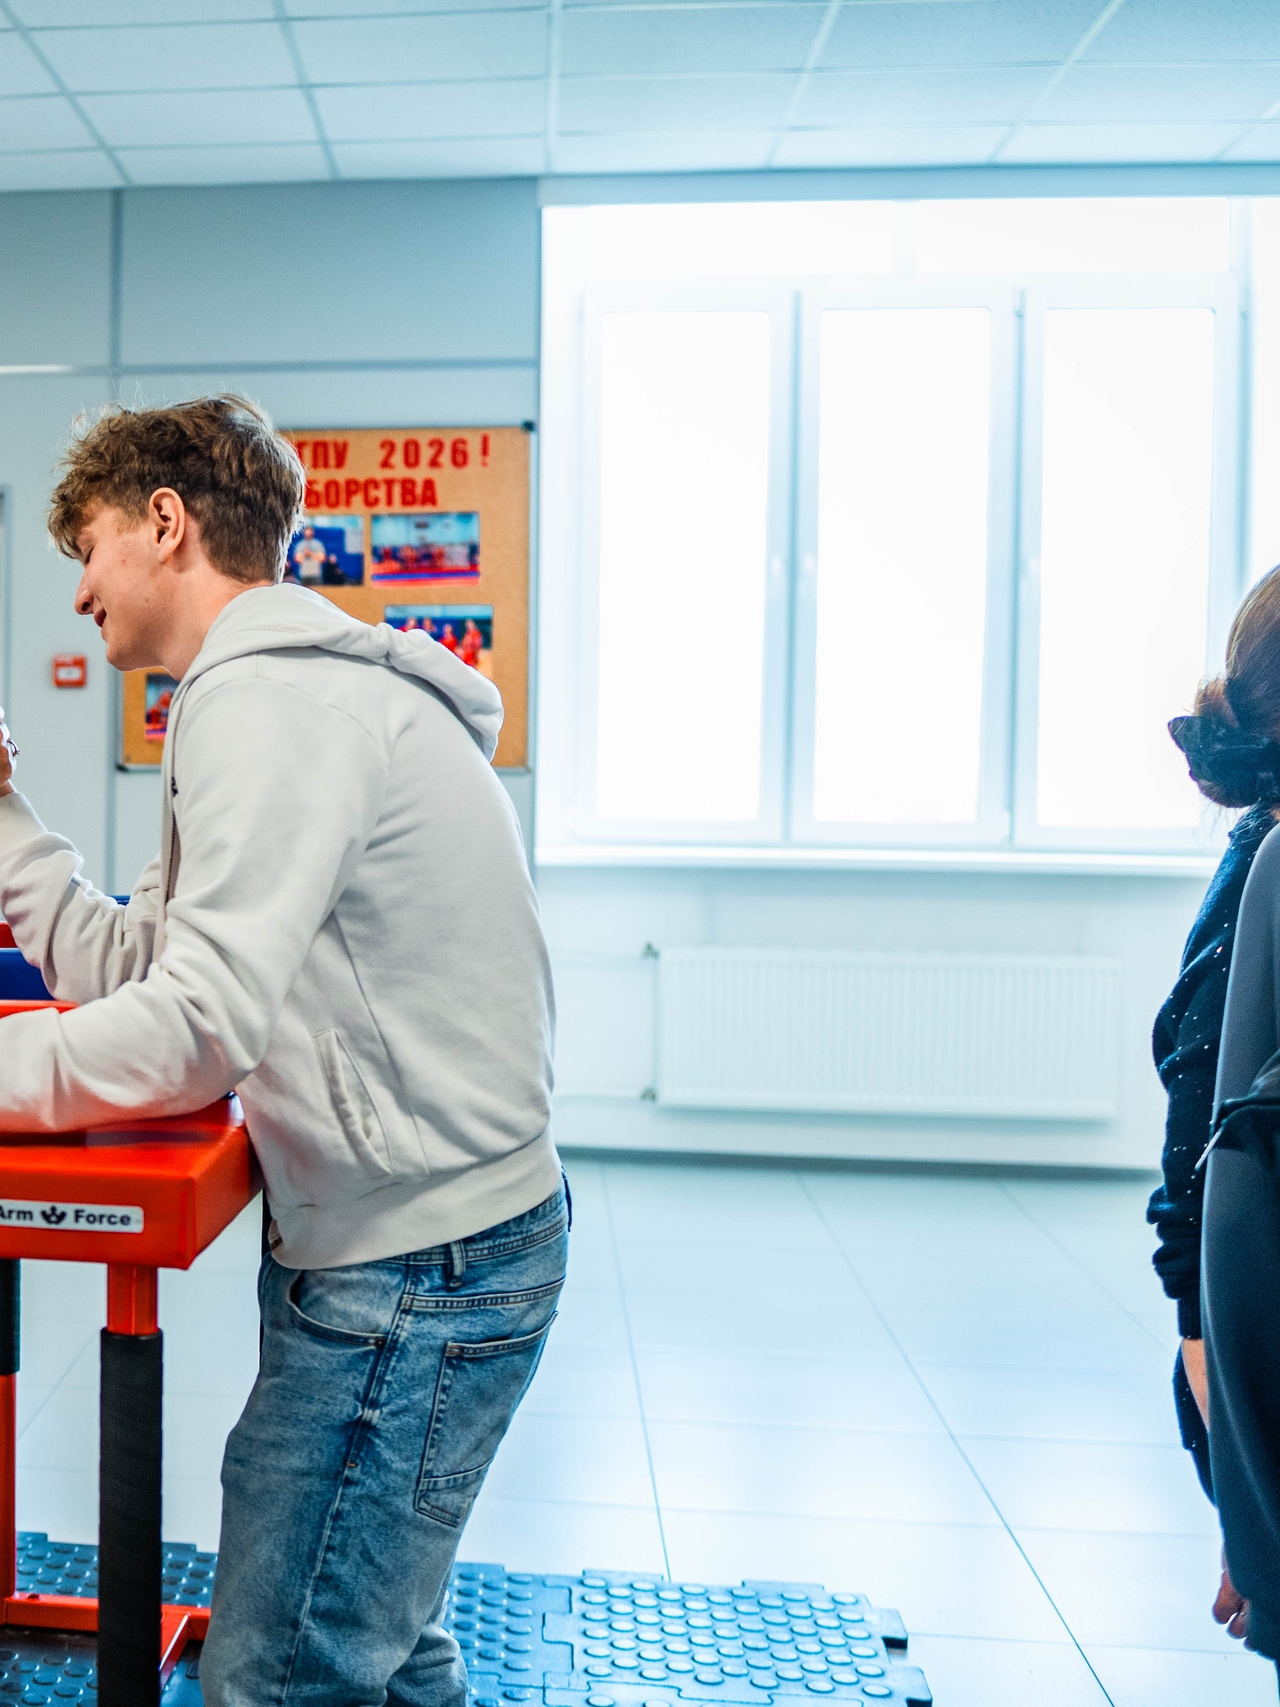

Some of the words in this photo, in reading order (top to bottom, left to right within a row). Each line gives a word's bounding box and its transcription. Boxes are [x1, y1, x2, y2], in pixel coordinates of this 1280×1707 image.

[295, 440, 349, 469] ГПУ
[304, 478, 437, 508] БОРСТВА
[74, 1209, 131, 1226] Force
